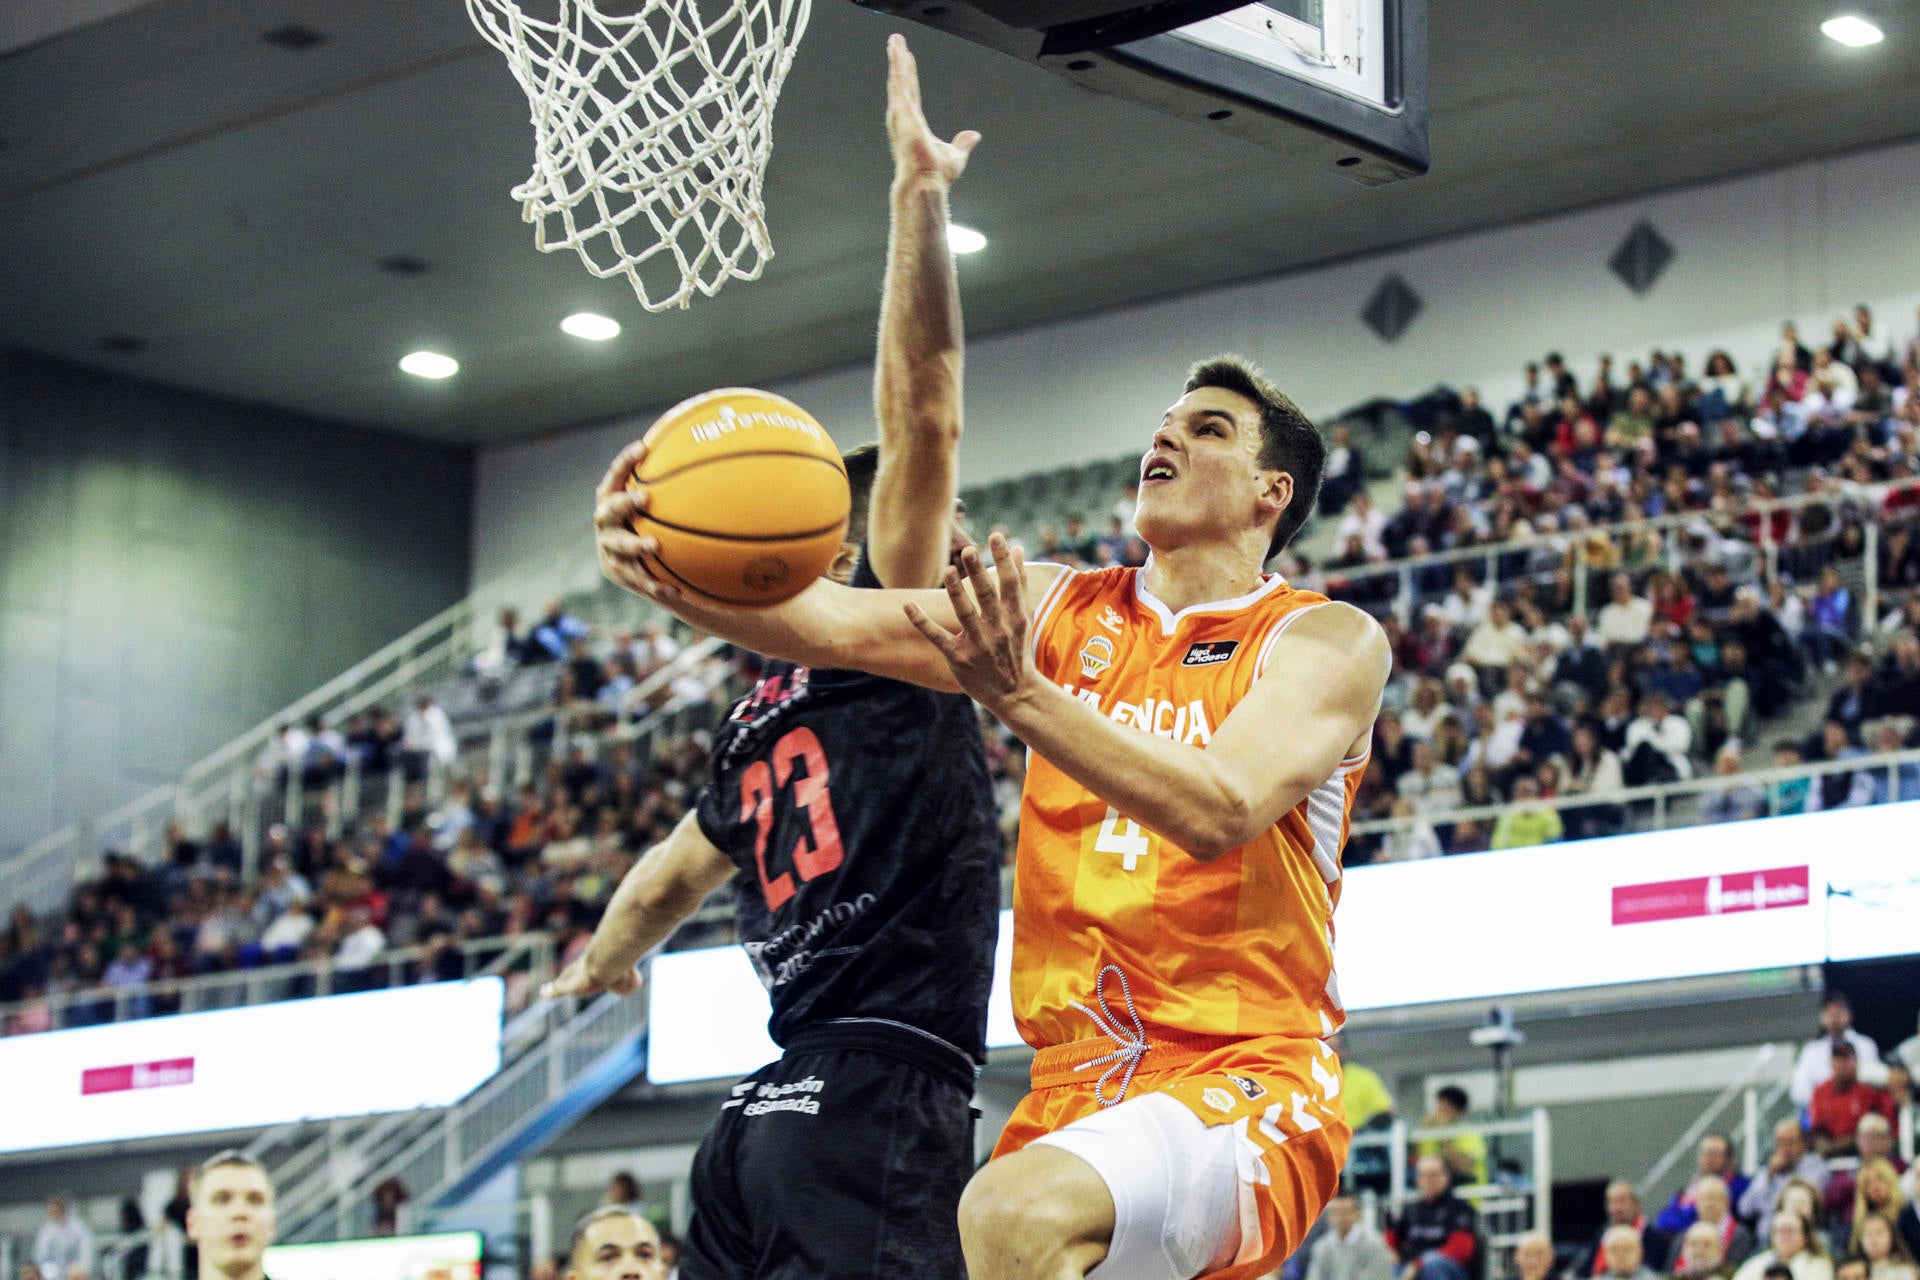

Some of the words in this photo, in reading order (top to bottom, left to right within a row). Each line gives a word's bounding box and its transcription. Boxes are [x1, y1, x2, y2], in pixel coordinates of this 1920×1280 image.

[1186, 652, 1229, 664] endesa
[1063, 683, 1212, 745] AENCIA
[740, 726, 845, 912] 23
[1094, 805, 1149, 871] 4
